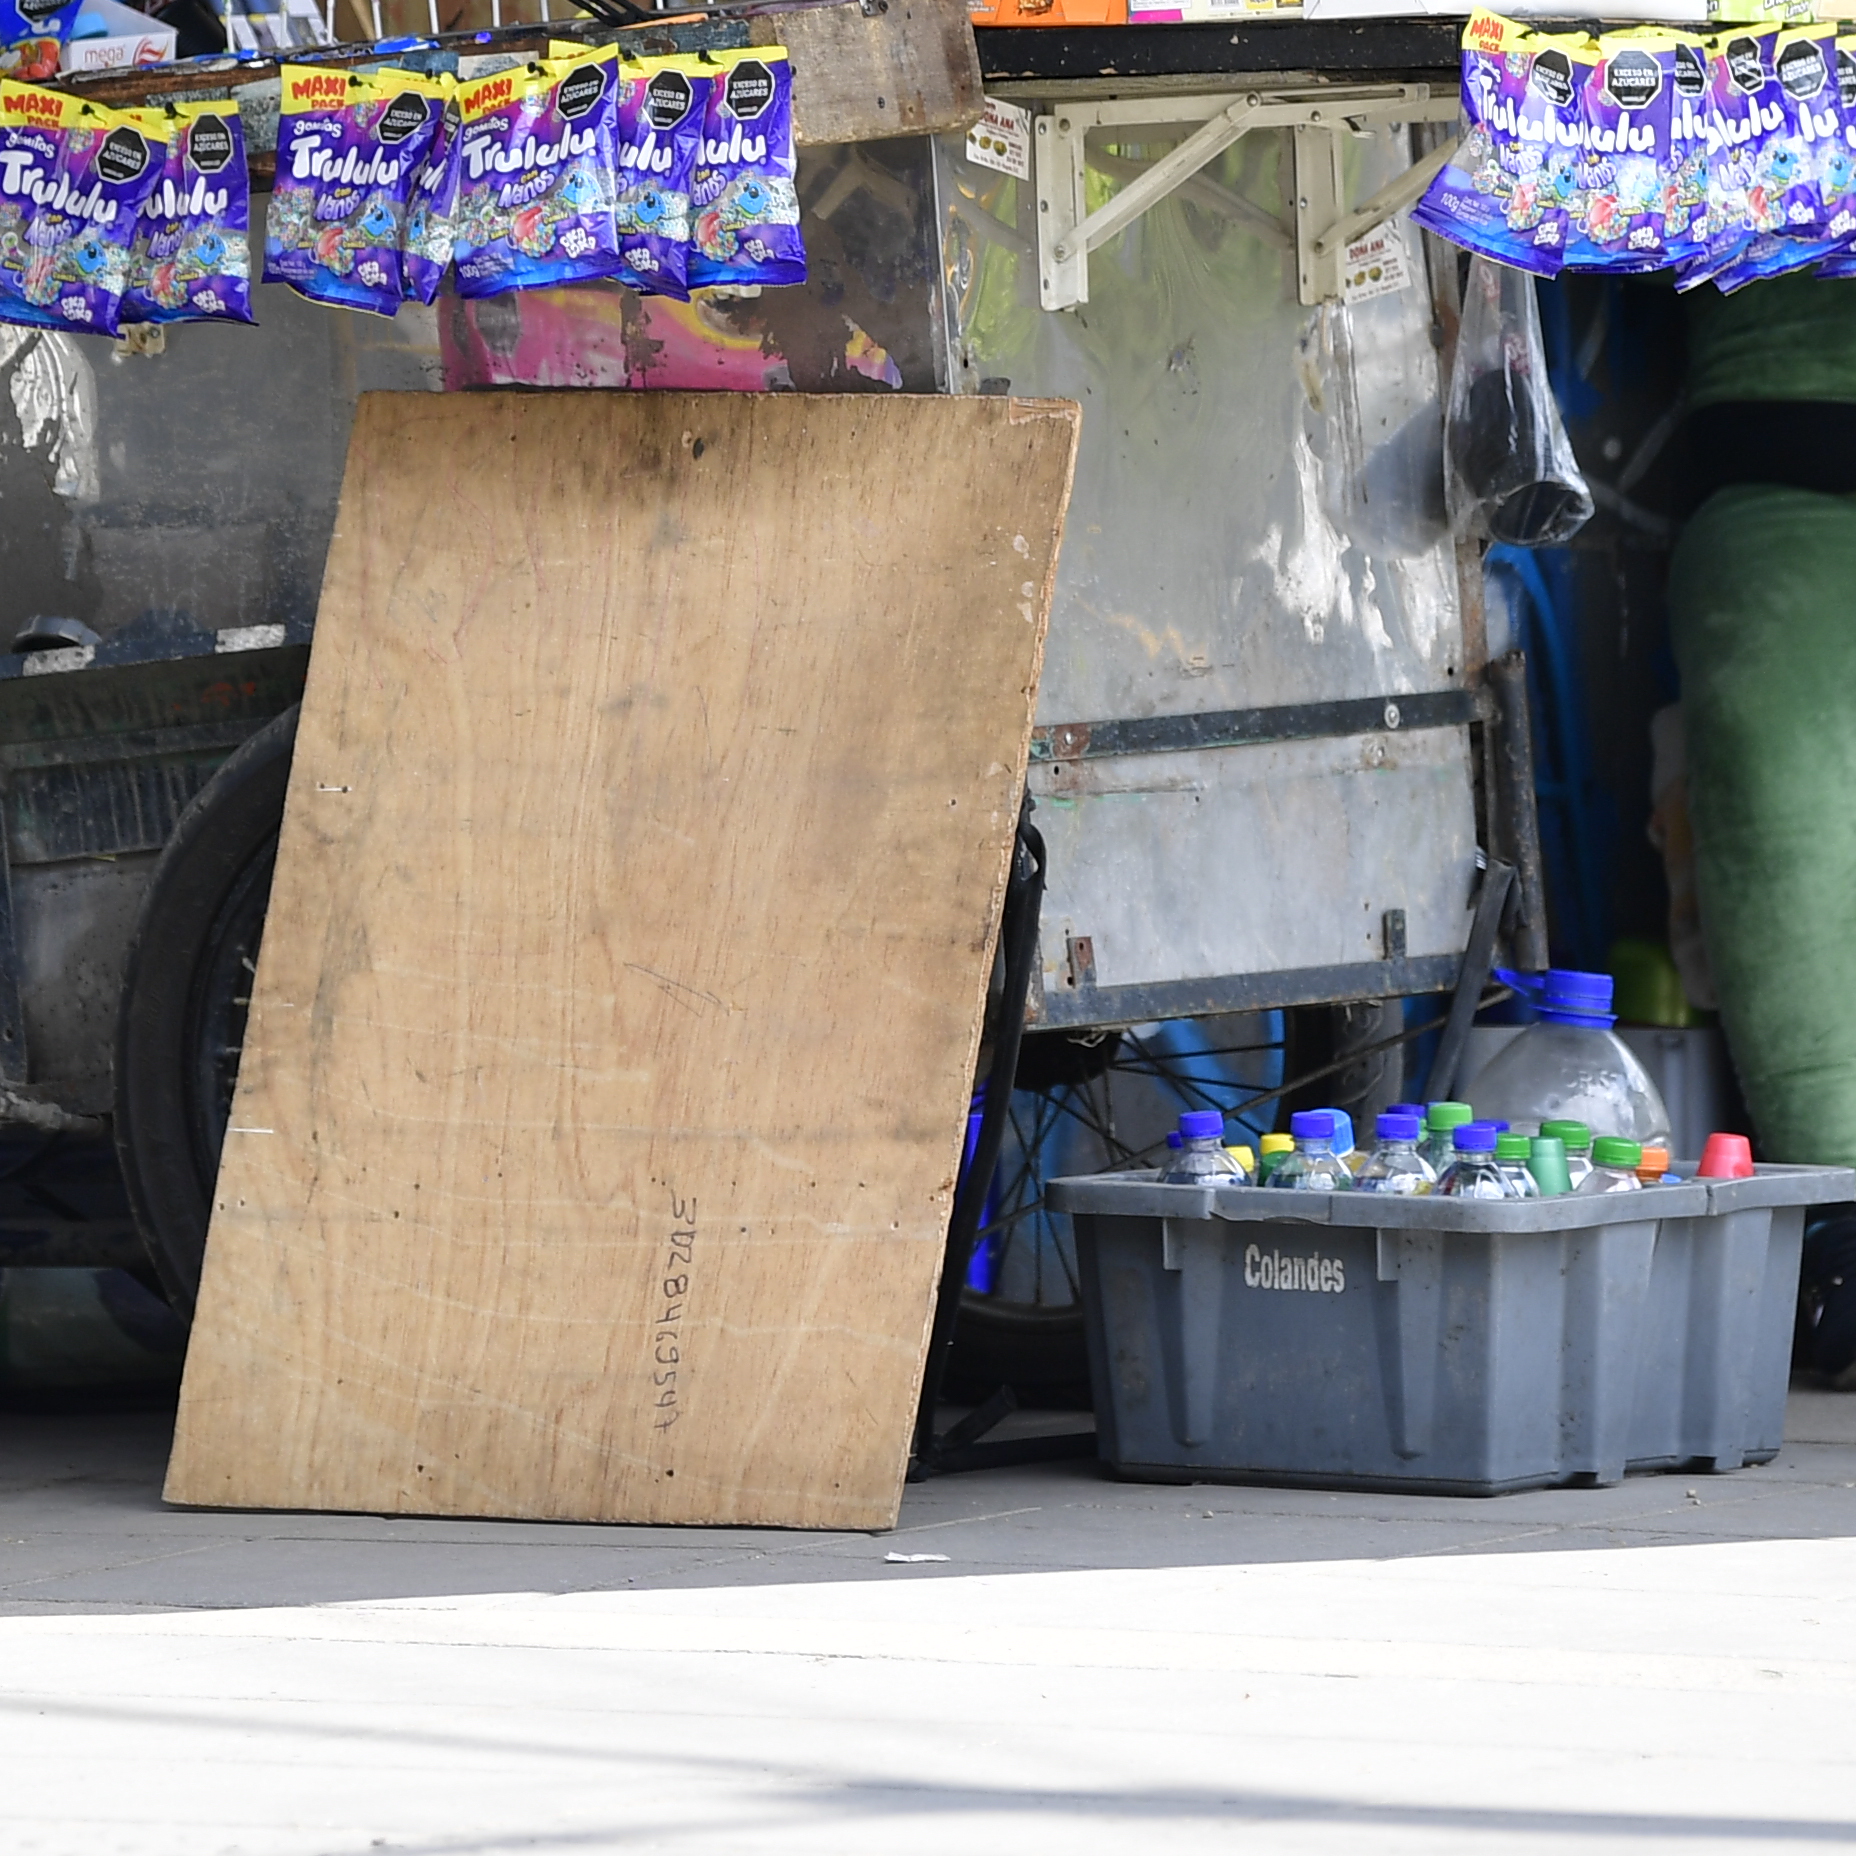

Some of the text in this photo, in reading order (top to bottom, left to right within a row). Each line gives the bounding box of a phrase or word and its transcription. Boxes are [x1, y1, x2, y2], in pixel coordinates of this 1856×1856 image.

[1470, 17, 1504, 41] MAXI
[84, 46, 124, 68] mega
[292, 76, 346, 100] MAXI
[464, 79, 512, 113] MAXI
[3, 93, 64, 117] MAXI
[311, 99, 345, 109] PACK
[27, 115, 59, 130] PACK
[294, 118, 341, 137] gomitas
[290, 135, 399, 184] Trululu
[462, 123, 595, 180] Trululu
[1244, 1243, 1345, 1295] Colandes
